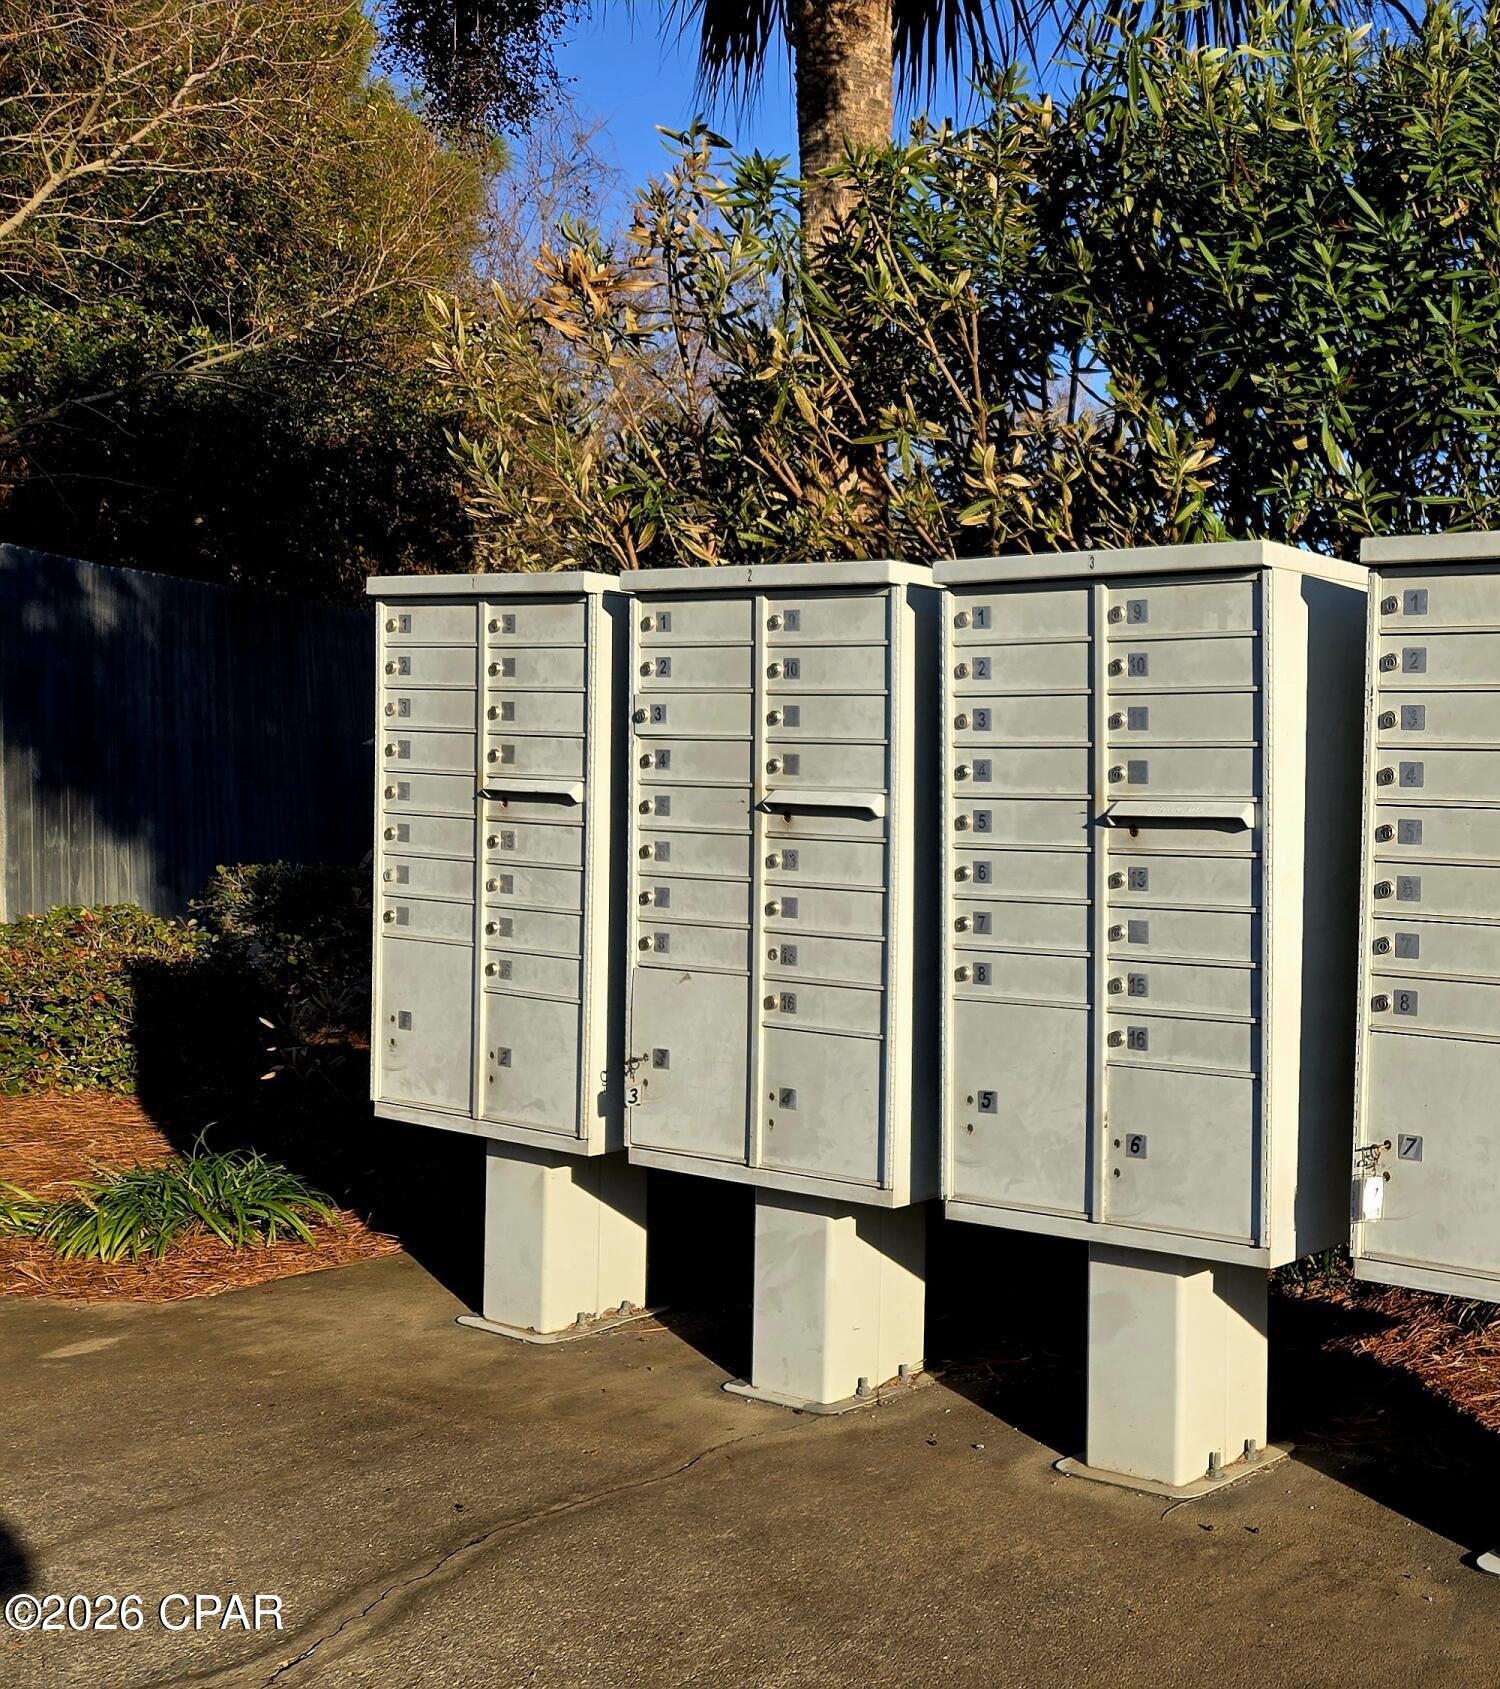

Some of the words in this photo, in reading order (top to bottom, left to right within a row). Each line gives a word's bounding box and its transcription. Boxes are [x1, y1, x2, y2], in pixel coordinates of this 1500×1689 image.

[1089, 556, 1095, 570] 3
[748, 568, 753, 582] 2
[1410, 593, 1418, 612] 1
[978, 609, 984, 625] 1
[1134, 603, 1142, 620] 9
[401, 617, 407, 631] 1
[506, 617, 512, 631] 9
[660, 614, 666, 630] 1
[401, 660, 407, 673] 2
[660, 660, 667, 675] 2
[978, 660, 986, 676] 2
[1130, 656, 1145, 673] 10
[1409, 652, 1419, 670] 2
[785, 662, 798, 677] 10
[401, 701, 407, 714] 3
[655, 706, 662, 721] 3
[978, 712, 986, 728] 3
[659, 752, 667, 767] 4
[1405, 766, 1416, 784] 4
[978, 813, 986, 829] 5
[978, 864, 986, 881] 6
[1131, 871, 1146, 888] 13
[978, 915, 986, 930] 7
[658, 936, 665, 950] 8
[978, 966, 986, 982] 8
[1130, 977, 1145, 995] 15
[1400, 993, 1410, 1011] 8
[1129, 1030, 1145, 1048] 16
[500, 1051, 508, 1065] 2
[627, 1088, 638, 1104] 3
[981, 1091, 993, 1109] 5
[1130, 1135, 1142, 1154] 6
[1402, 1137, 1418, 1156] 7
